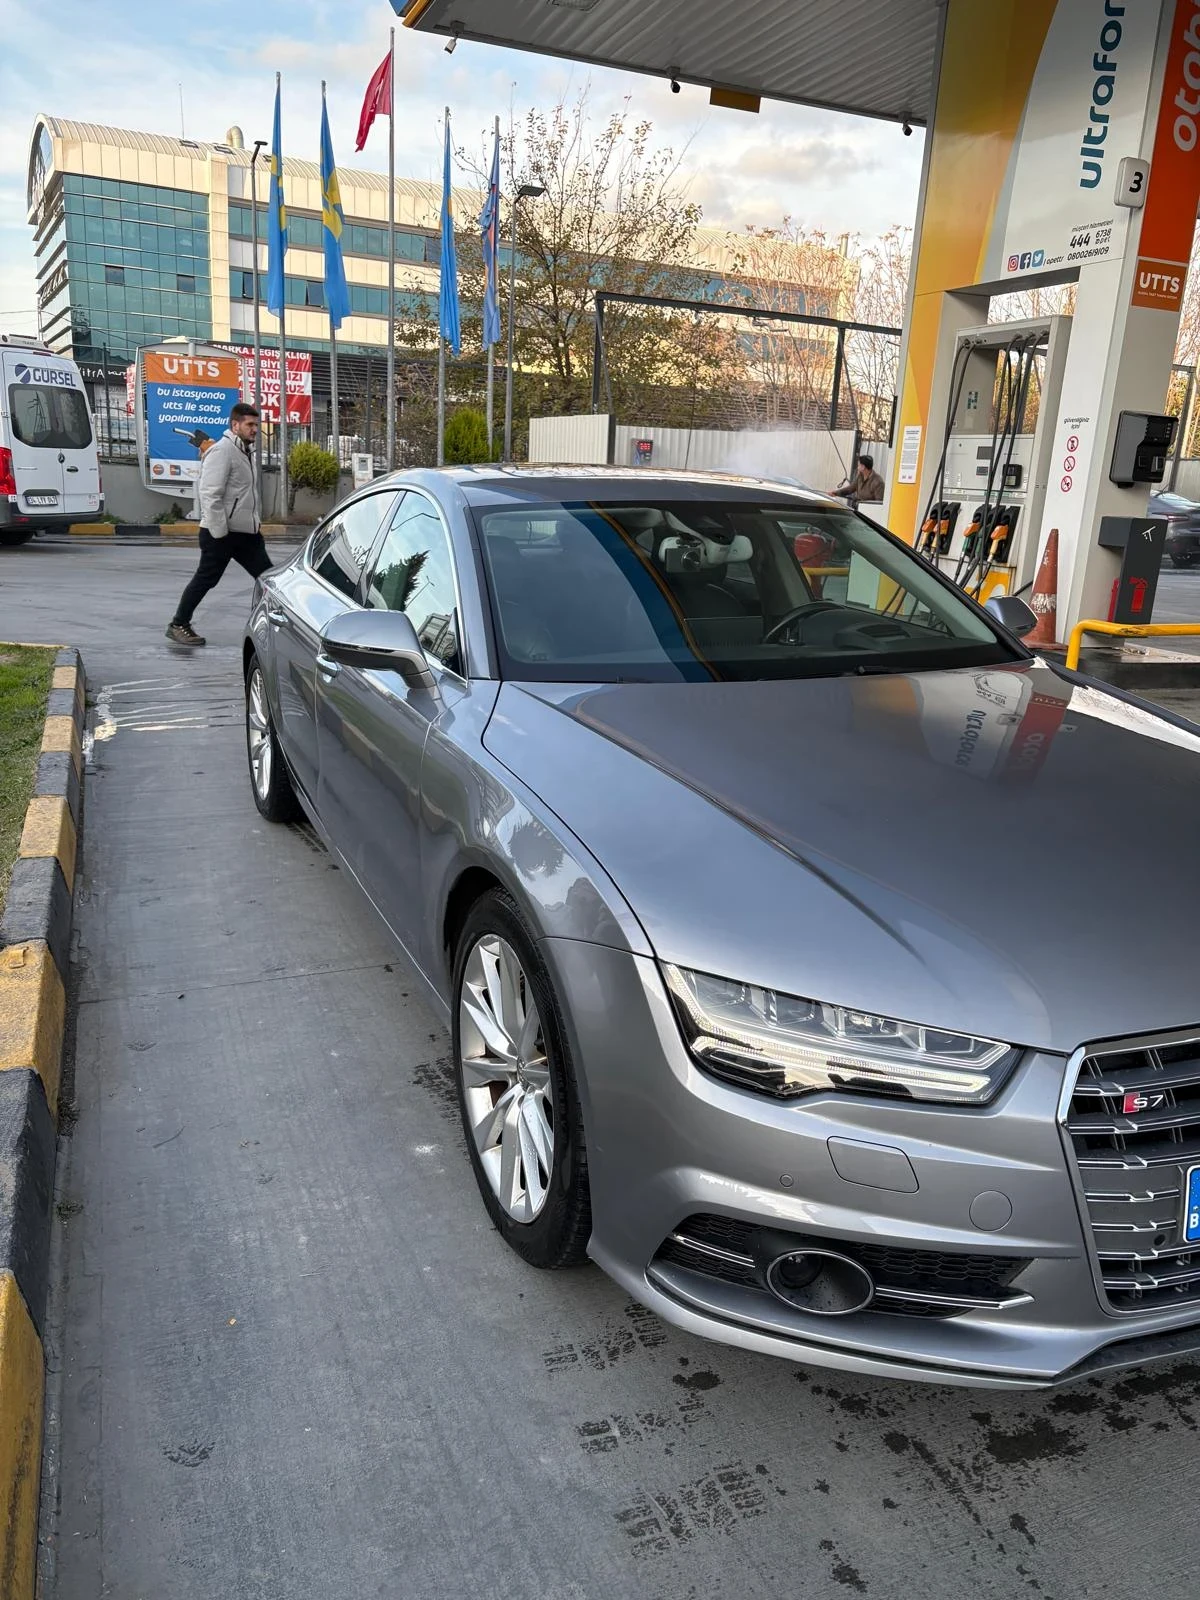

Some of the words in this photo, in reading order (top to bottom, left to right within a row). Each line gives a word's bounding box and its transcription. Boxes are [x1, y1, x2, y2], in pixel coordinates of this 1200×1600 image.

[1128, 171, 1144, 193] 3
[1069, 232, 1091, 248] 444
[1095, 227, 1112, 239] 6738
[1139, 271, 1180, 293] UTTS
[163, 357, 220, 378] UTTS
[32, 367, 77, 387] GÜRSEL
[156, 387, 170, 396] bu
[172, 388, 226, 401] istasyonda
[162, 401, 183, 410] utts
[198, 404, 222, 414] satış
[1133, 1094, 1164, 1108] S7
